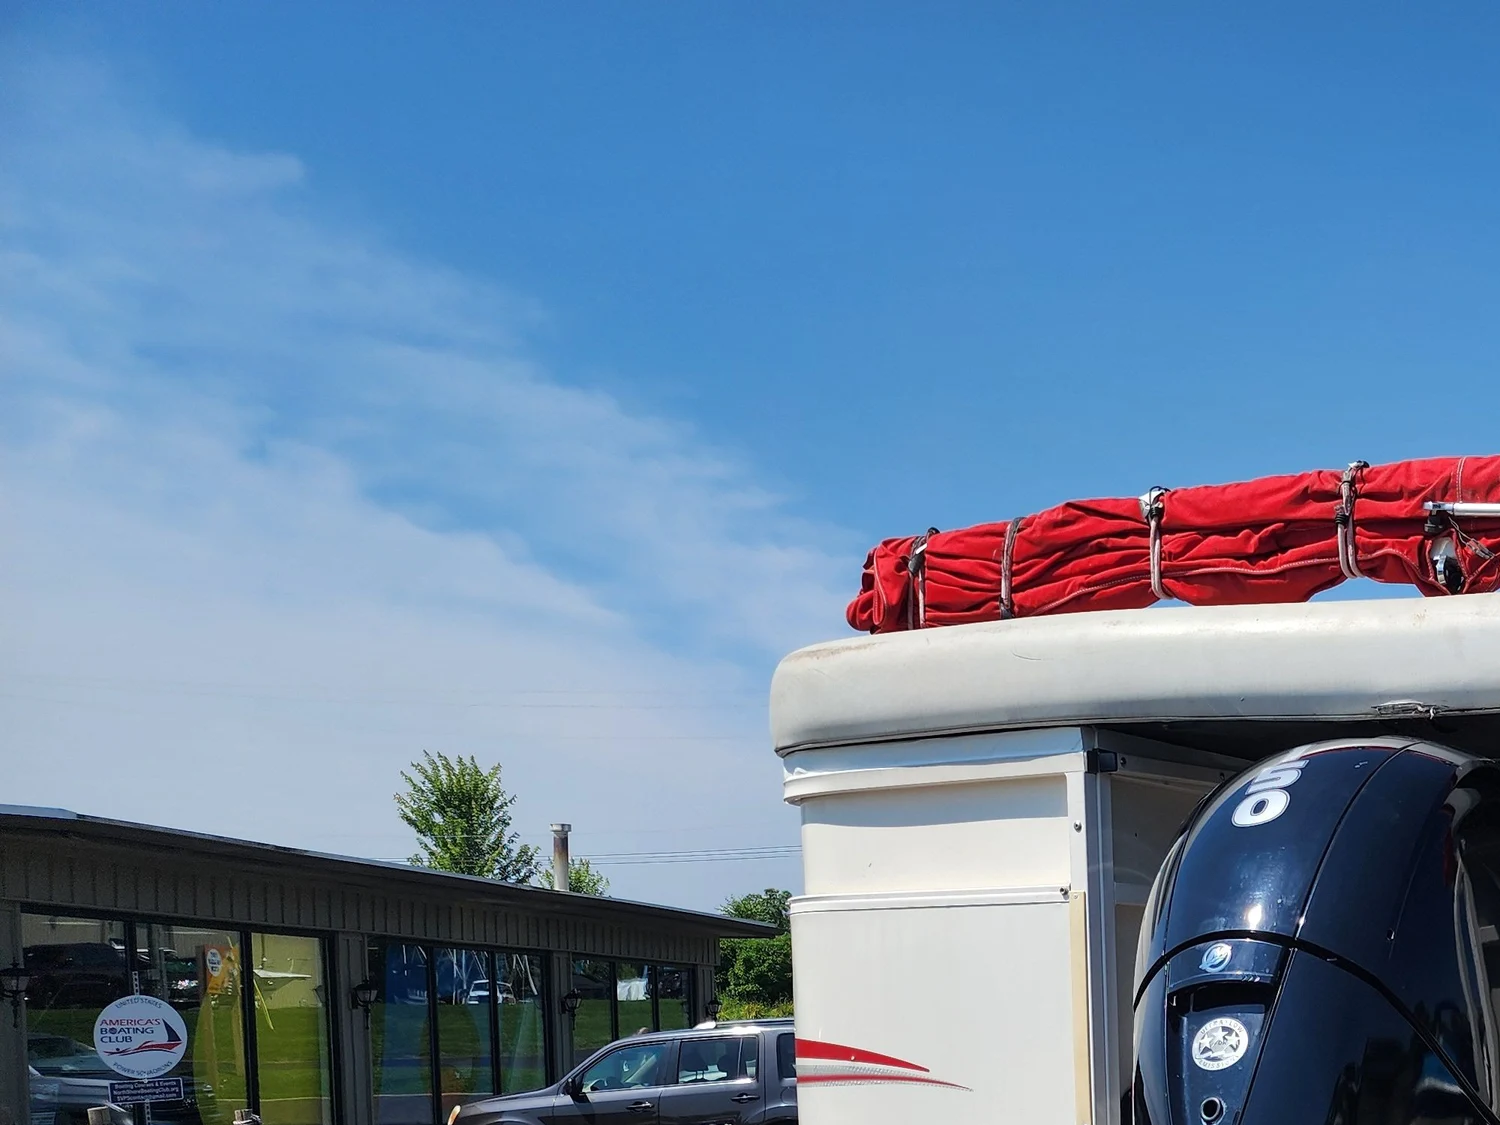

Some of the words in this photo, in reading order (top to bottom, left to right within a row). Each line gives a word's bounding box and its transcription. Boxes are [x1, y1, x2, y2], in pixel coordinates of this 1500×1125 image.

[116, 997, 139, 1009] UNITED
[141, 997, 162, 1009] STATES
[100, 1018, 161, 1027] AMERICA'S
[100, 1027, 154, 1035] BOATING
[100, 1035, 133, 1043] CLUB
[113, 1061, 135, 1075] POWER
[136, 1060, 173, 1077] SQUADRONS
